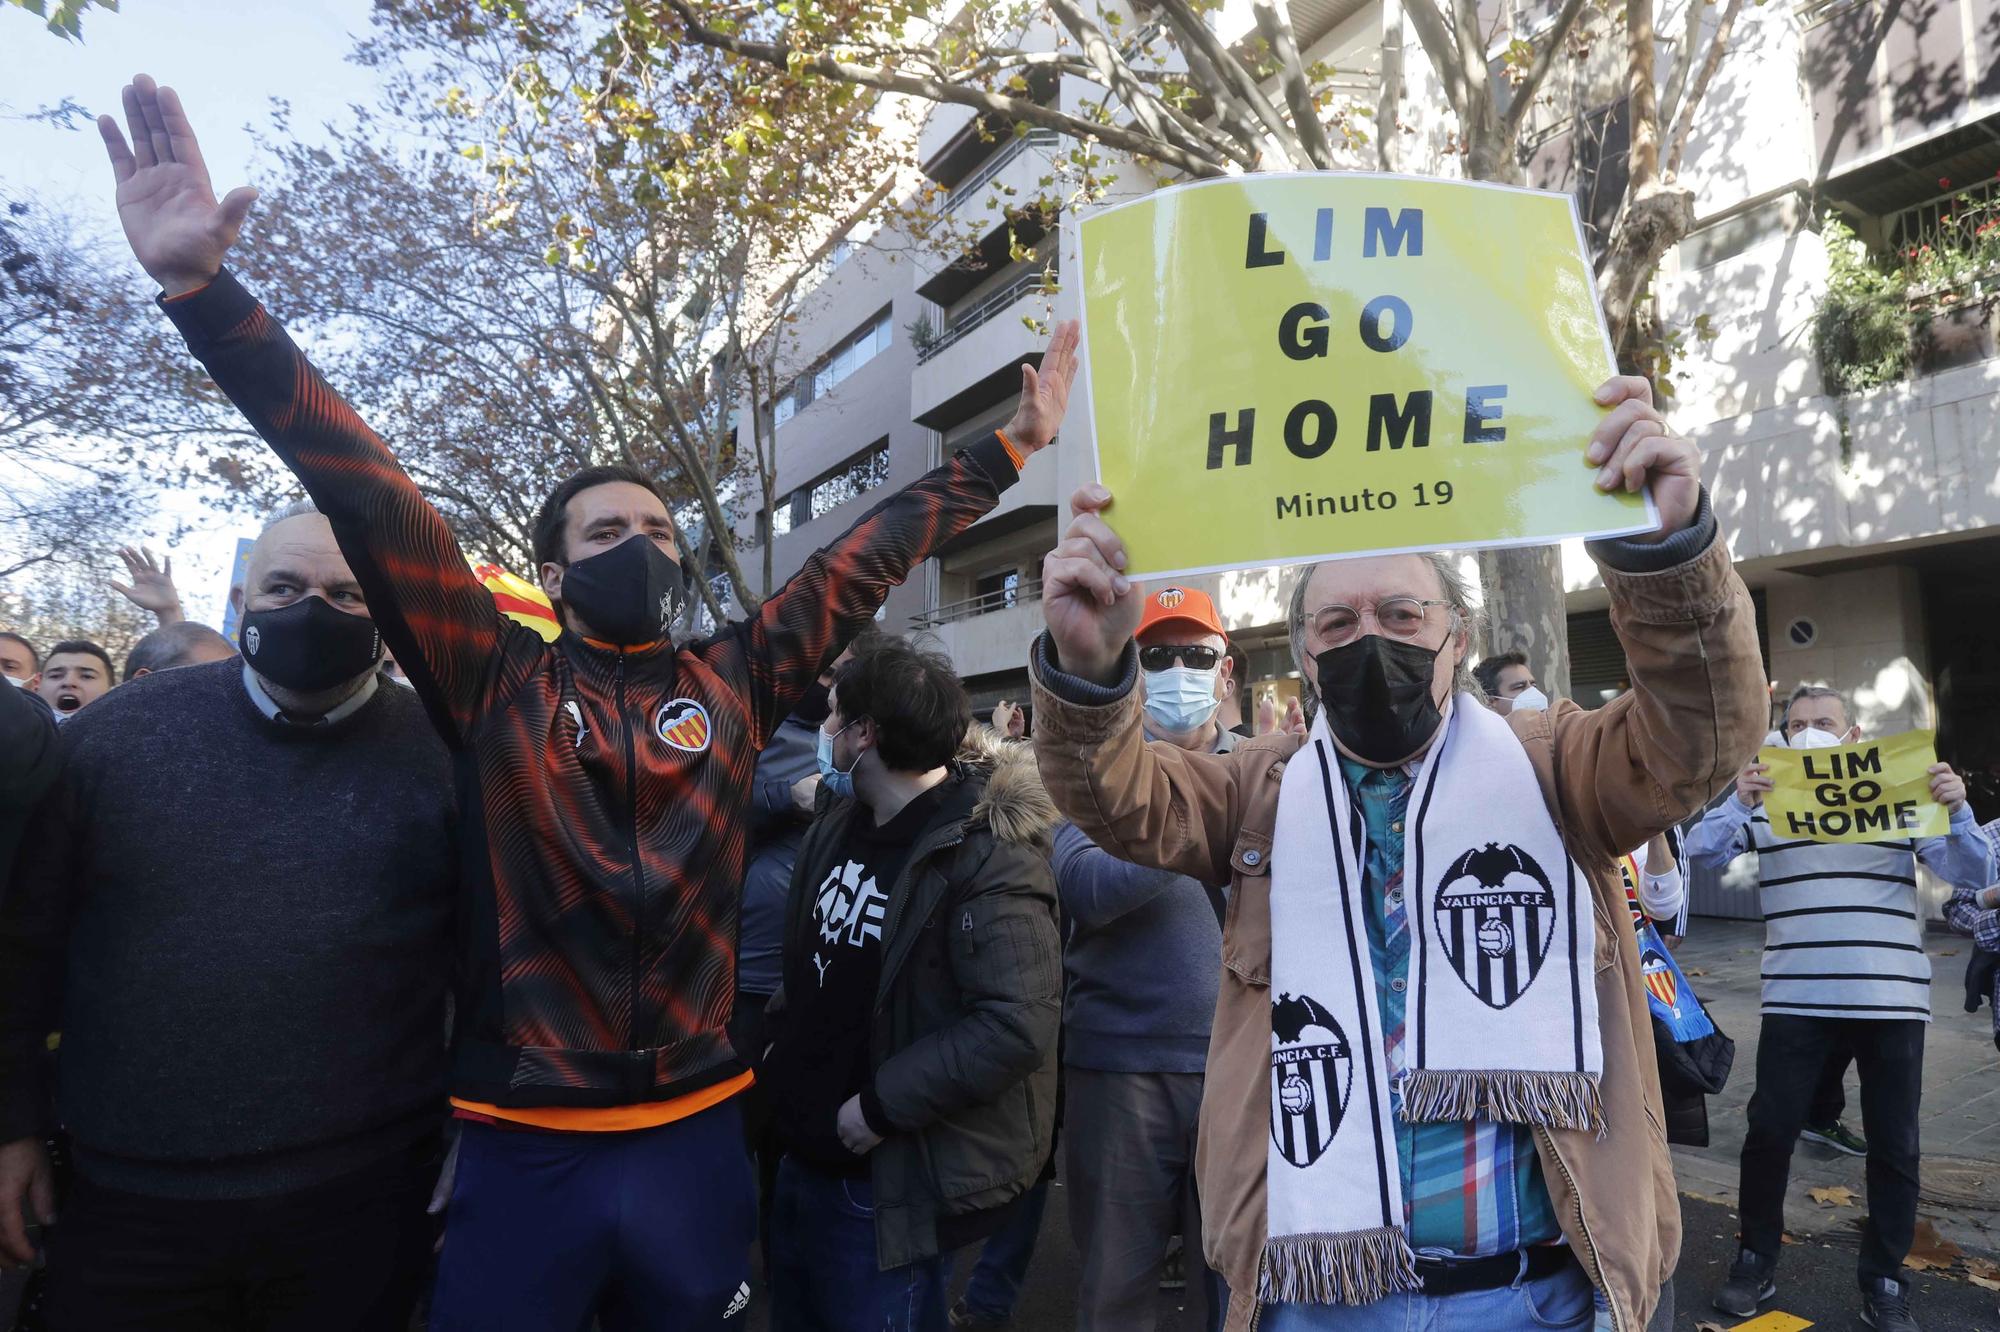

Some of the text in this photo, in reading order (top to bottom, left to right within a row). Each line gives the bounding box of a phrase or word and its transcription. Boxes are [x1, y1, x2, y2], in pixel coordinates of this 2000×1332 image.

[1245, 207, 1424, 269] LIM
[1278, 294, 1414, 361] GO
[1206, 383, 1509, 470] HOME
[1275, 479, 1455, 520] Minuto 19
[1802, 746, 1882, 780] LIM
[1815, 780, 1882, 807] GO
[1786, 799, 1921, 836] HOME
[1440, 893, 1516, 908] VALENCIA
